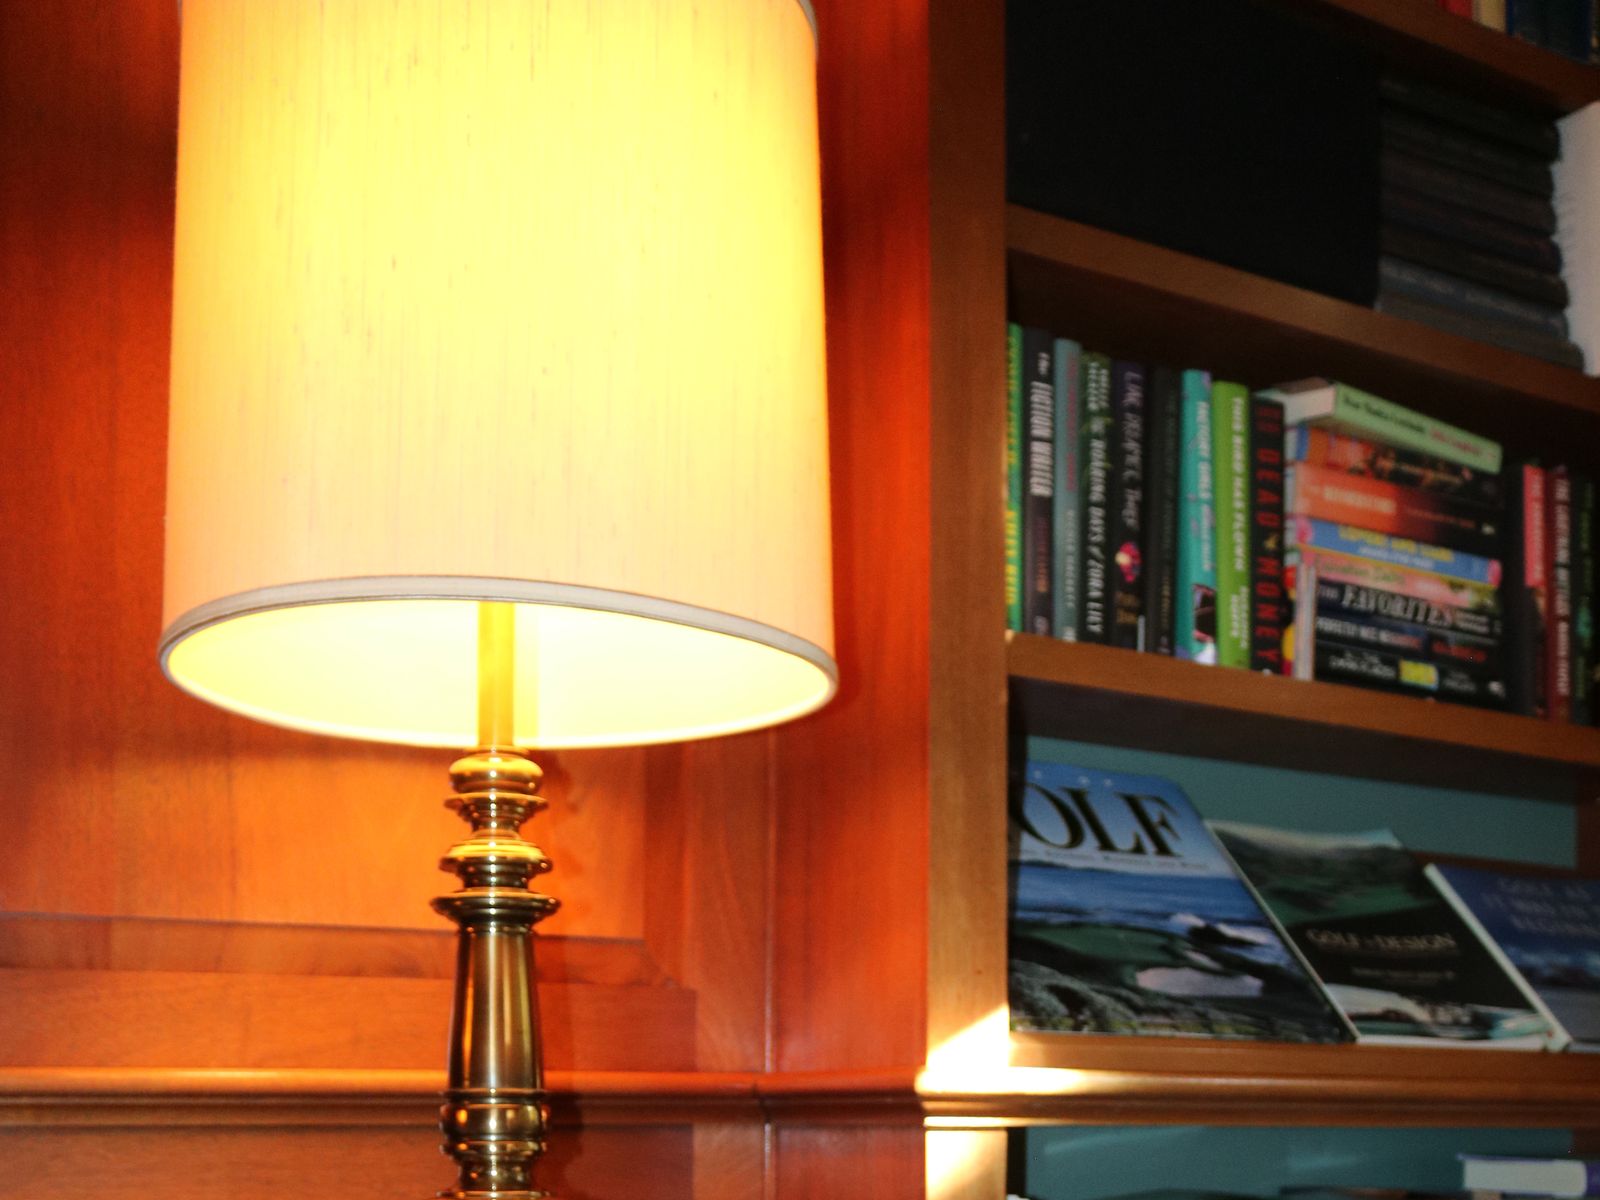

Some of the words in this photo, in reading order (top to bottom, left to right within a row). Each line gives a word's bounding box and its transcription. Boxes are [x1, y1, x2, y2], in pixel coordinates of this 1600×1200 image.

[1255, 447, 1281, 529] DEAD
[1255, 556, 1281, 663] MONEY
[1341, 583, 1453, 628] FAVORITES
[1018, 781, 1184, 858] OLF
[1374, 933, 1458, 951] DESIGN
